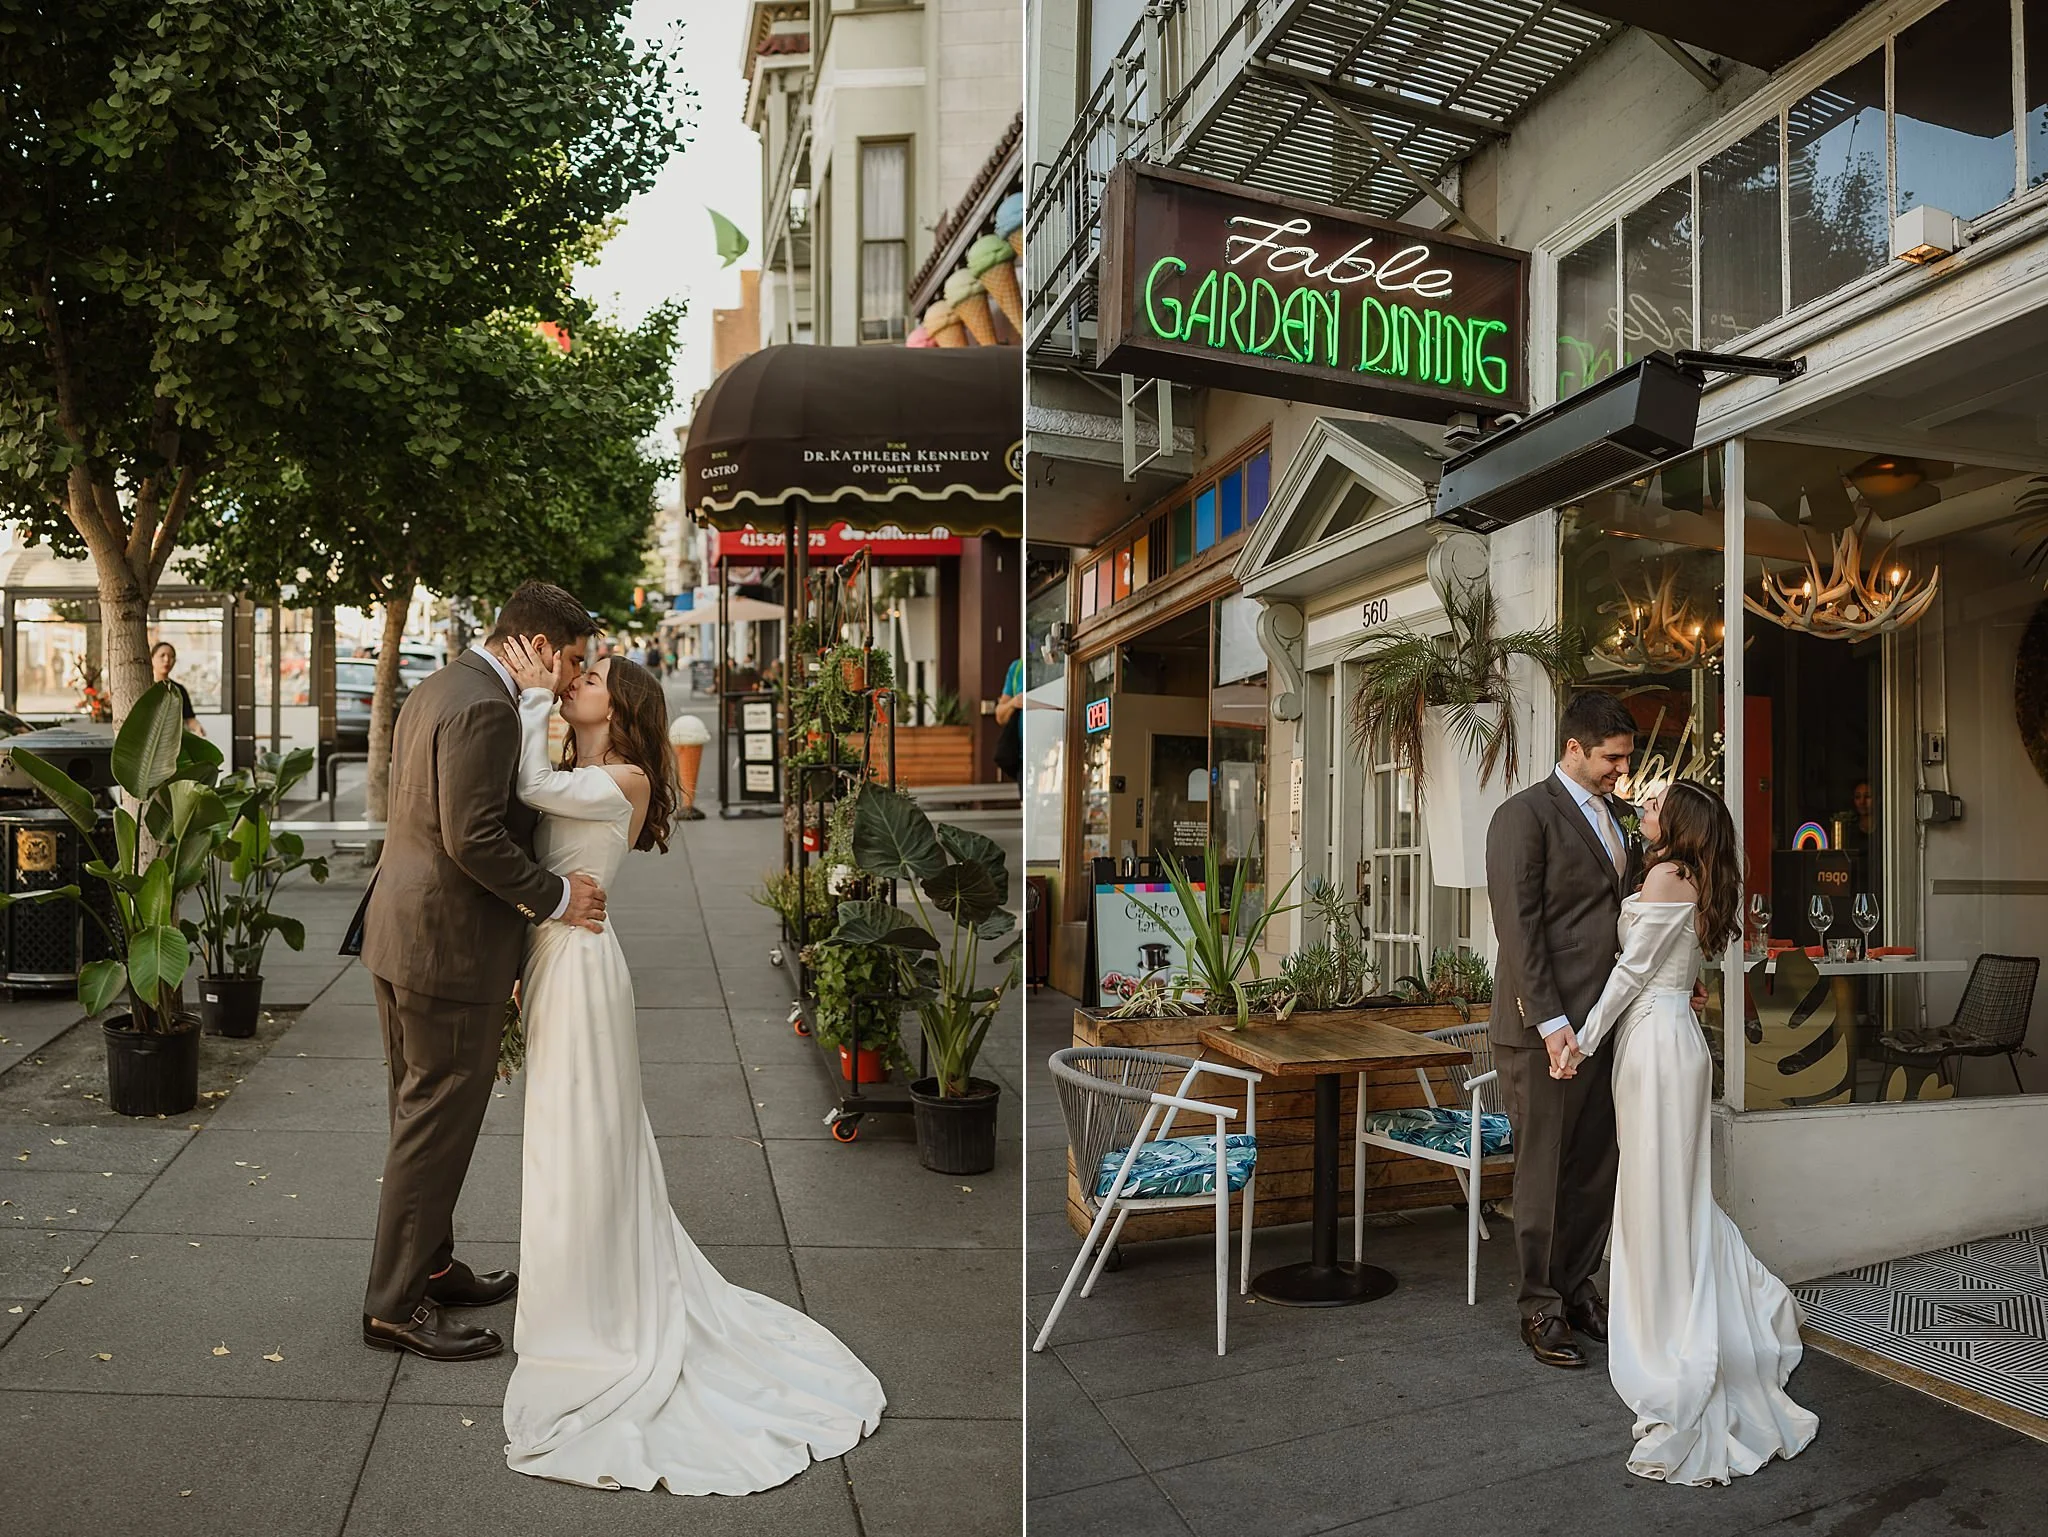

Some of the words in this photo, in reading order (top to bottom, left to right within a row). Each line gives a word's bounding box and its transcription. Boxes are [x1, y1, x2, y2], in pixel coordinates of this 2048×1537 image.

[1224, 216, 1453, 297] Fable
[1145, 256, 1340, 368] GARDEN
[1352, 296, 1508, 394] DINING
[852, 463, 942, 474] OPTOMETRIST
[917, 450, 990, 461] KENNEDY
[700, 463, 739, 480] CASTRO
[1362, 598, 1389, 629] 560
[1088, 701, 1108, 729] OPEN
